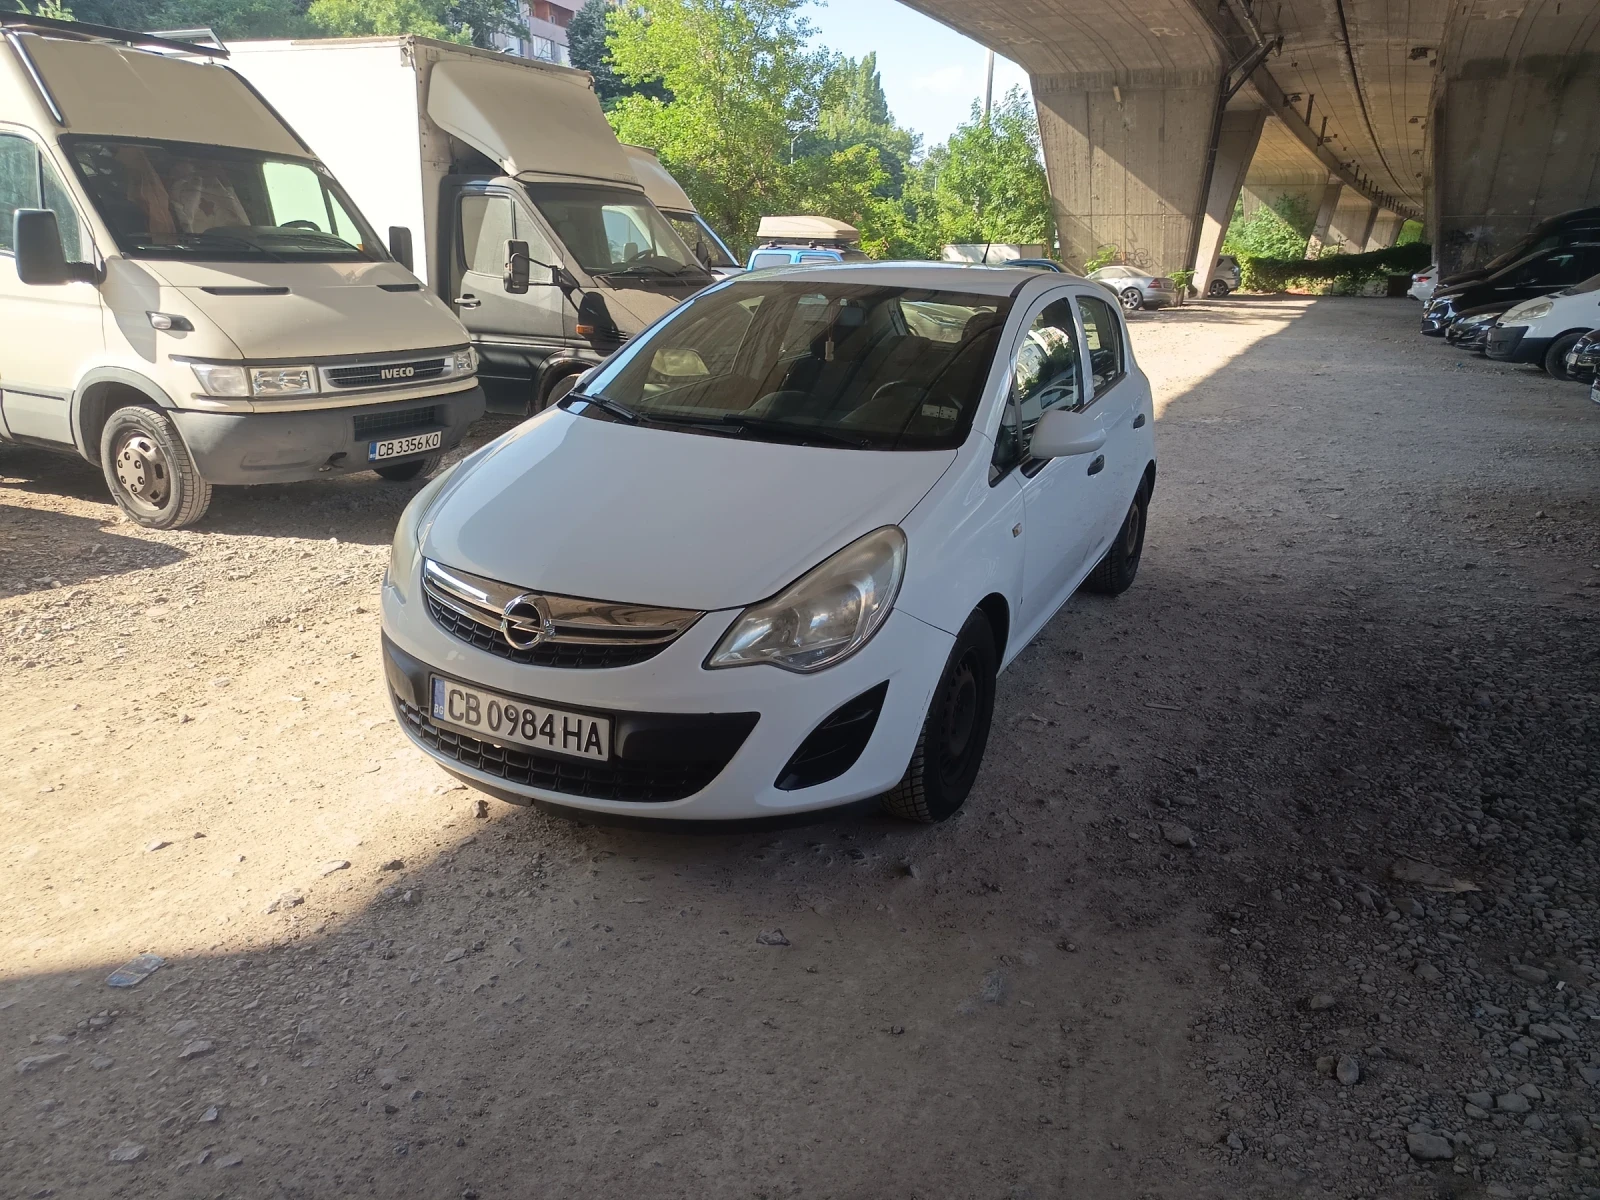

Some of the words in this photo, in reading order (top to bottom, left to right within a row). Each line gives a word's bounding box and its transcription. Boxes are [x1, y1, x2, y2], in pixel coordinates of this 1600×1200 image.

[381, 367, 415, 379] IVECO
[378, 442, 394, 457] CB
[396, 437, 424, 454] 3356
[433, 703, 444, 716] BG
[448, 689, 482, 726] CB
[486, 700, 556, 746] 0984
[562, 716, 603, 755] HA
